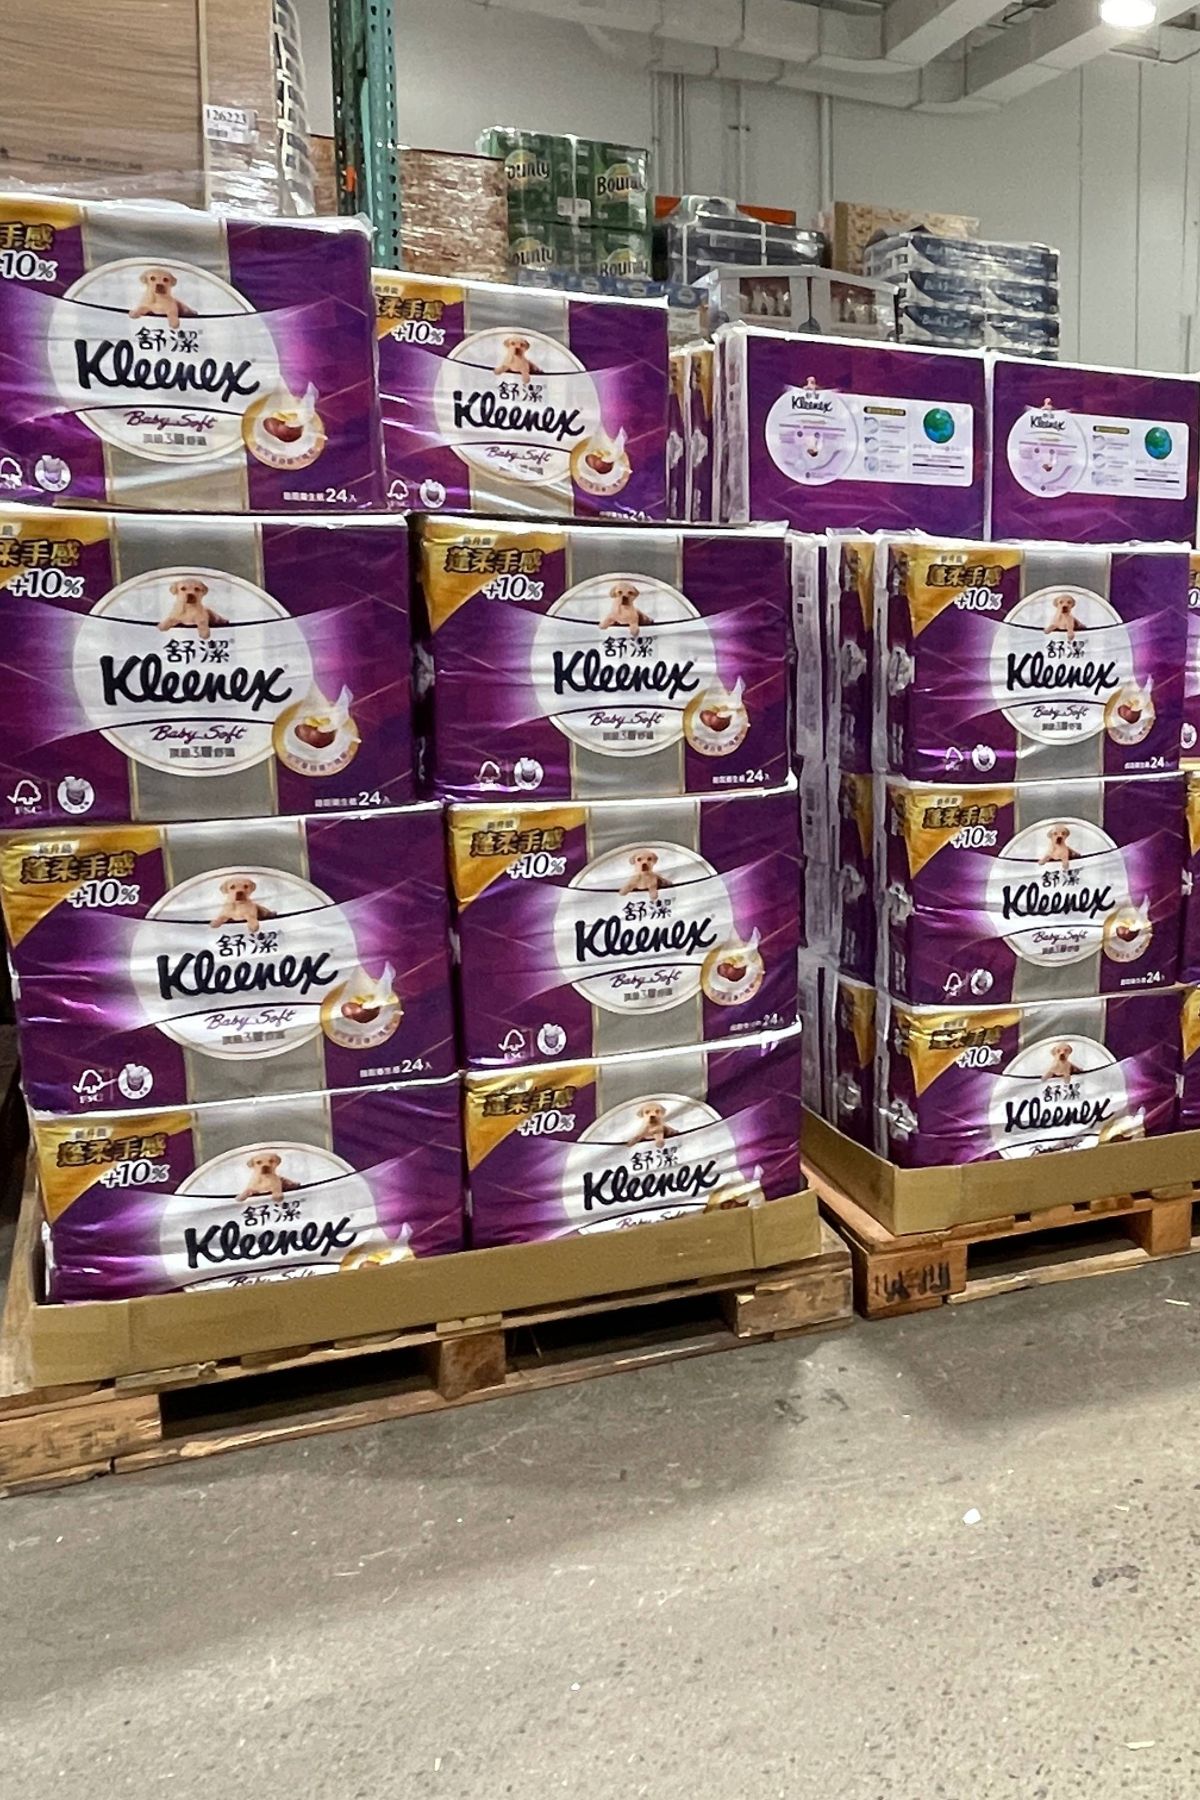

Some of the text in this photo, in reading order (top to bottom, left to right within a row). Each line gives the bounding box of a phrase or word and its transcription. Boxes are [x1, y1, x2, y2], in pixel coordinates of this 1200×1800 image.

[0, 223, 53, 250] 手感
[0, 252, 56, 279] 10%
[136, 328, 198, 353] 舒潔
[75, 340, 259, 402] Kleenex
[499, 382, 544, 402] 舒潔
[453, 391, 585, 441] Kleenex
[792, 396, 833, 414] Kleenex
[125, 410, 218, 430] Baby Soft
[485, 447, 552, 462] Baby Soft
[0, 540, 80, 567] 柔手感
[9, 569, 84, 596] +10%
[484, 574, 544, 601] +10%
[955, 588, 1002, 610] +10%
[163, 639, 230, 663] 舒潔
[604, 637, 653, 658] 舒潔
[100, 653, 293, 711] Kleenex
[553, 649, 699, 699] Kleenex
[1006, 652, 1120, 696] Kleenex
[589, 711, 664, 727] Baby Soft
[1032, 705, 1090, 719] Baby Soft
[150, 724, 247, 742] Baby Soft
[952, 826, 998, 848] +10%
[508, 854, 565, 878] +10%
[69, 879, 140, 908] +10%
[1002, 883, 1116, 920] Kleenex
[623, 900, 672, 922] 舒潔
[218, 932, 279, 957] 舒潔
[576, 917, 717, 962] Kleenex
[1032, 930, 1060, 943] Baby
[157, 951, 338, 999] Kleenex
[611, 969, 682, 989] Baby Soft
[204, 1009, 296, 1030] Baby Soft
[518, 1111, 575, 1136] +10%
[1005, 1099, 1115, 1132] Kleenex
[632, 1149, 679, 1172] 舒潔
[102, 1160, 169, 1188] +10%
[583, 1160, 721, 1210] Kleenex
[243, 1202, 301, 1227] 舒潔
[184, 1216, 358, 1269] Kleenex
